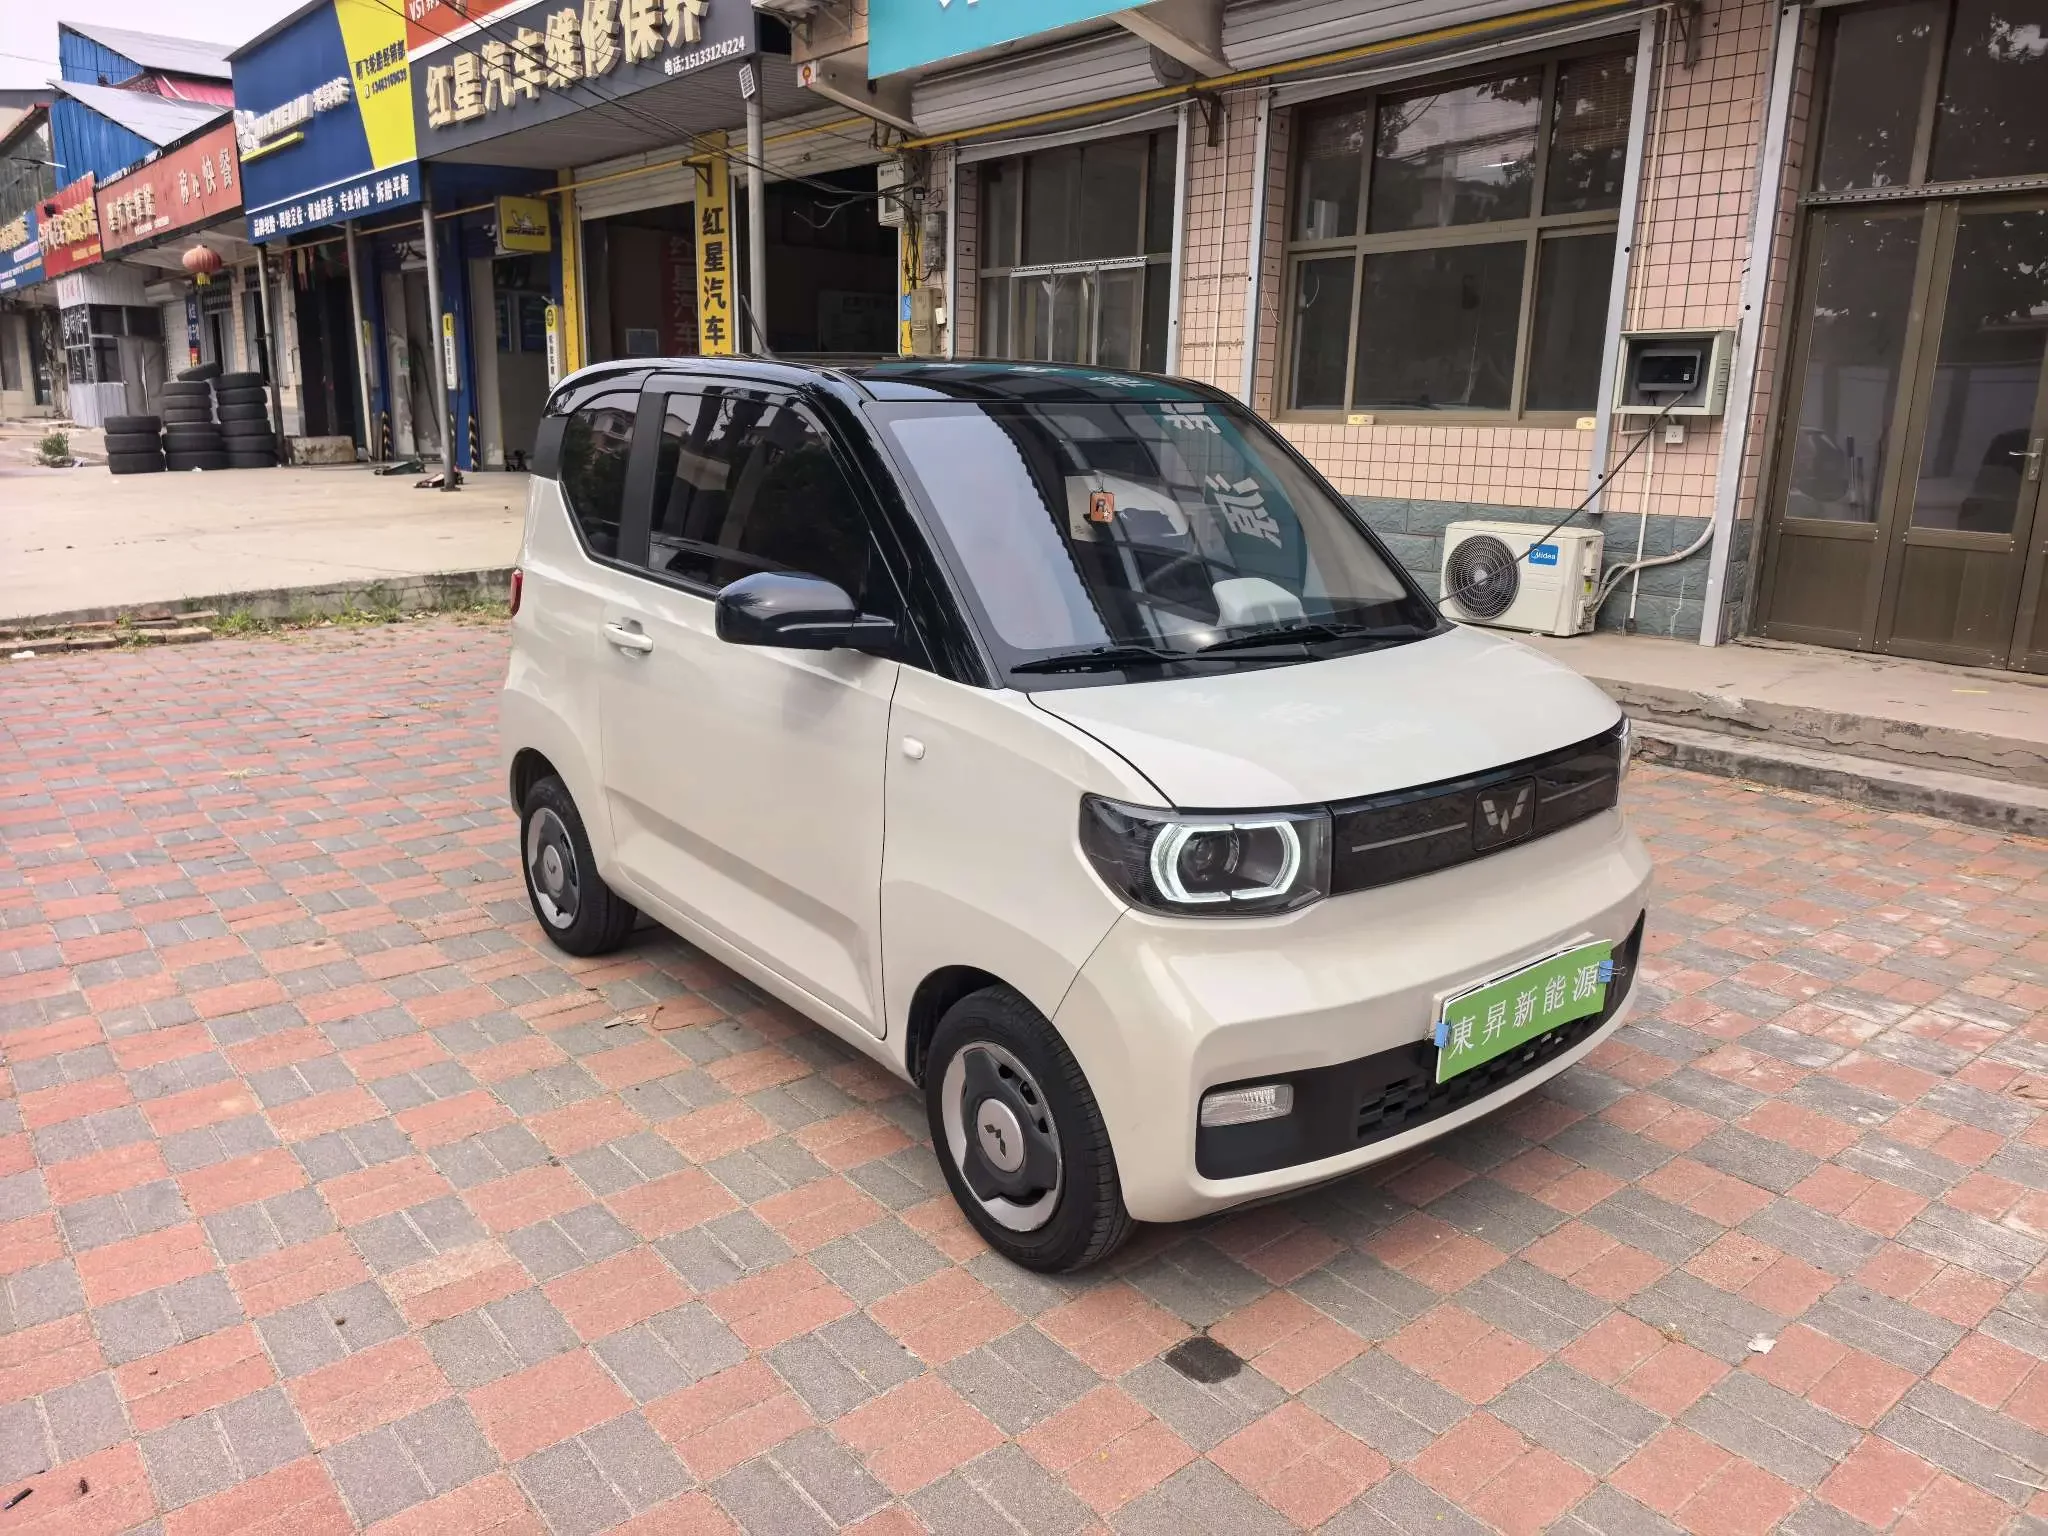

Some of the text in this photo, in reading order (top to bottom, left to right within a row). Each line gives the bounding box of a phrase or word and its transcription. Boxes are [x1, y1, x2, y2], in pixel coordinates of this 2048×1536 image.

[426, 0, 708, 129] 红星汽车维修保养
[664, 35, 745, 76] 电话:15133124224
[702, 206, 726, 355] 红星汽车
[1531, 549, 1556, 560] Midea
[1449, 962, 1600, 1060] 東昇新能源
